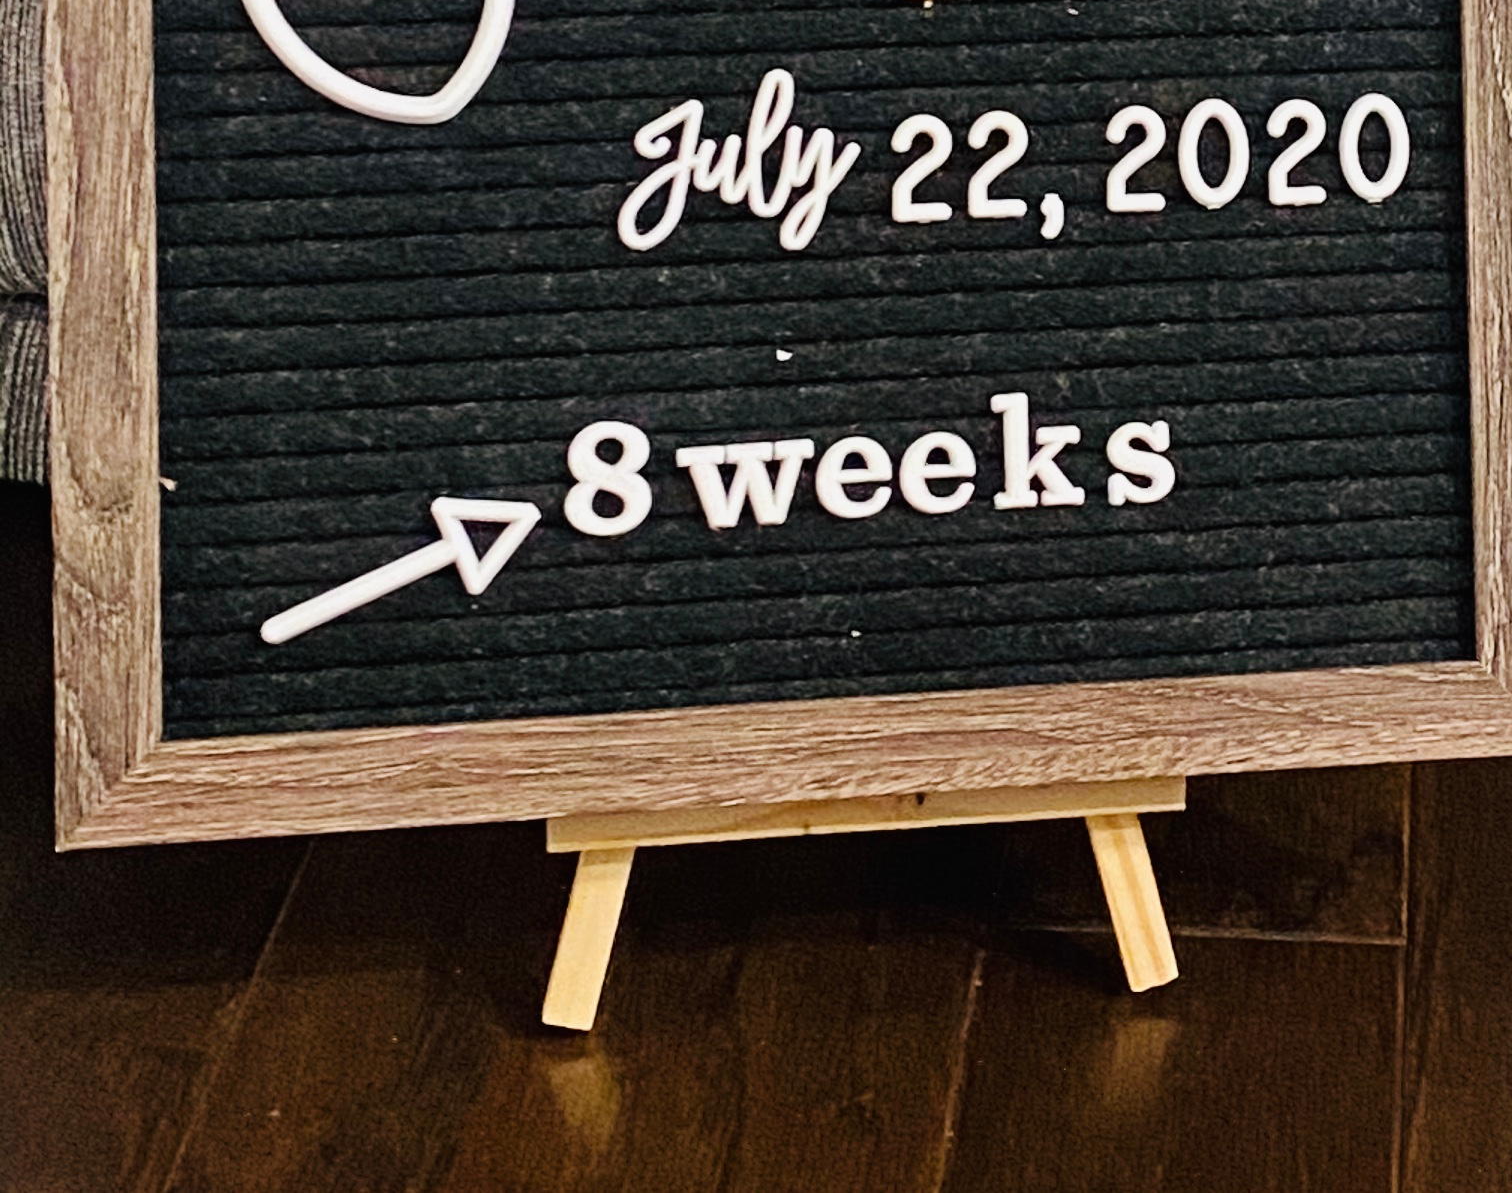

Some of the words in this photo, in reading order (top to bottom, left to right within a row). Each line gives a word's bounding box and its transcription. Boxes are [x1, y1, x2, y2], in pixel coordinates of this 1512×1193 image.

[617, 68, 861, 252] July
[890, 110, 1066, 240] 22,
[1105, 92, 1411, 214] 2020
[563, 420, 653, 538] 8
[675, 392, 1176, 532] weeks
